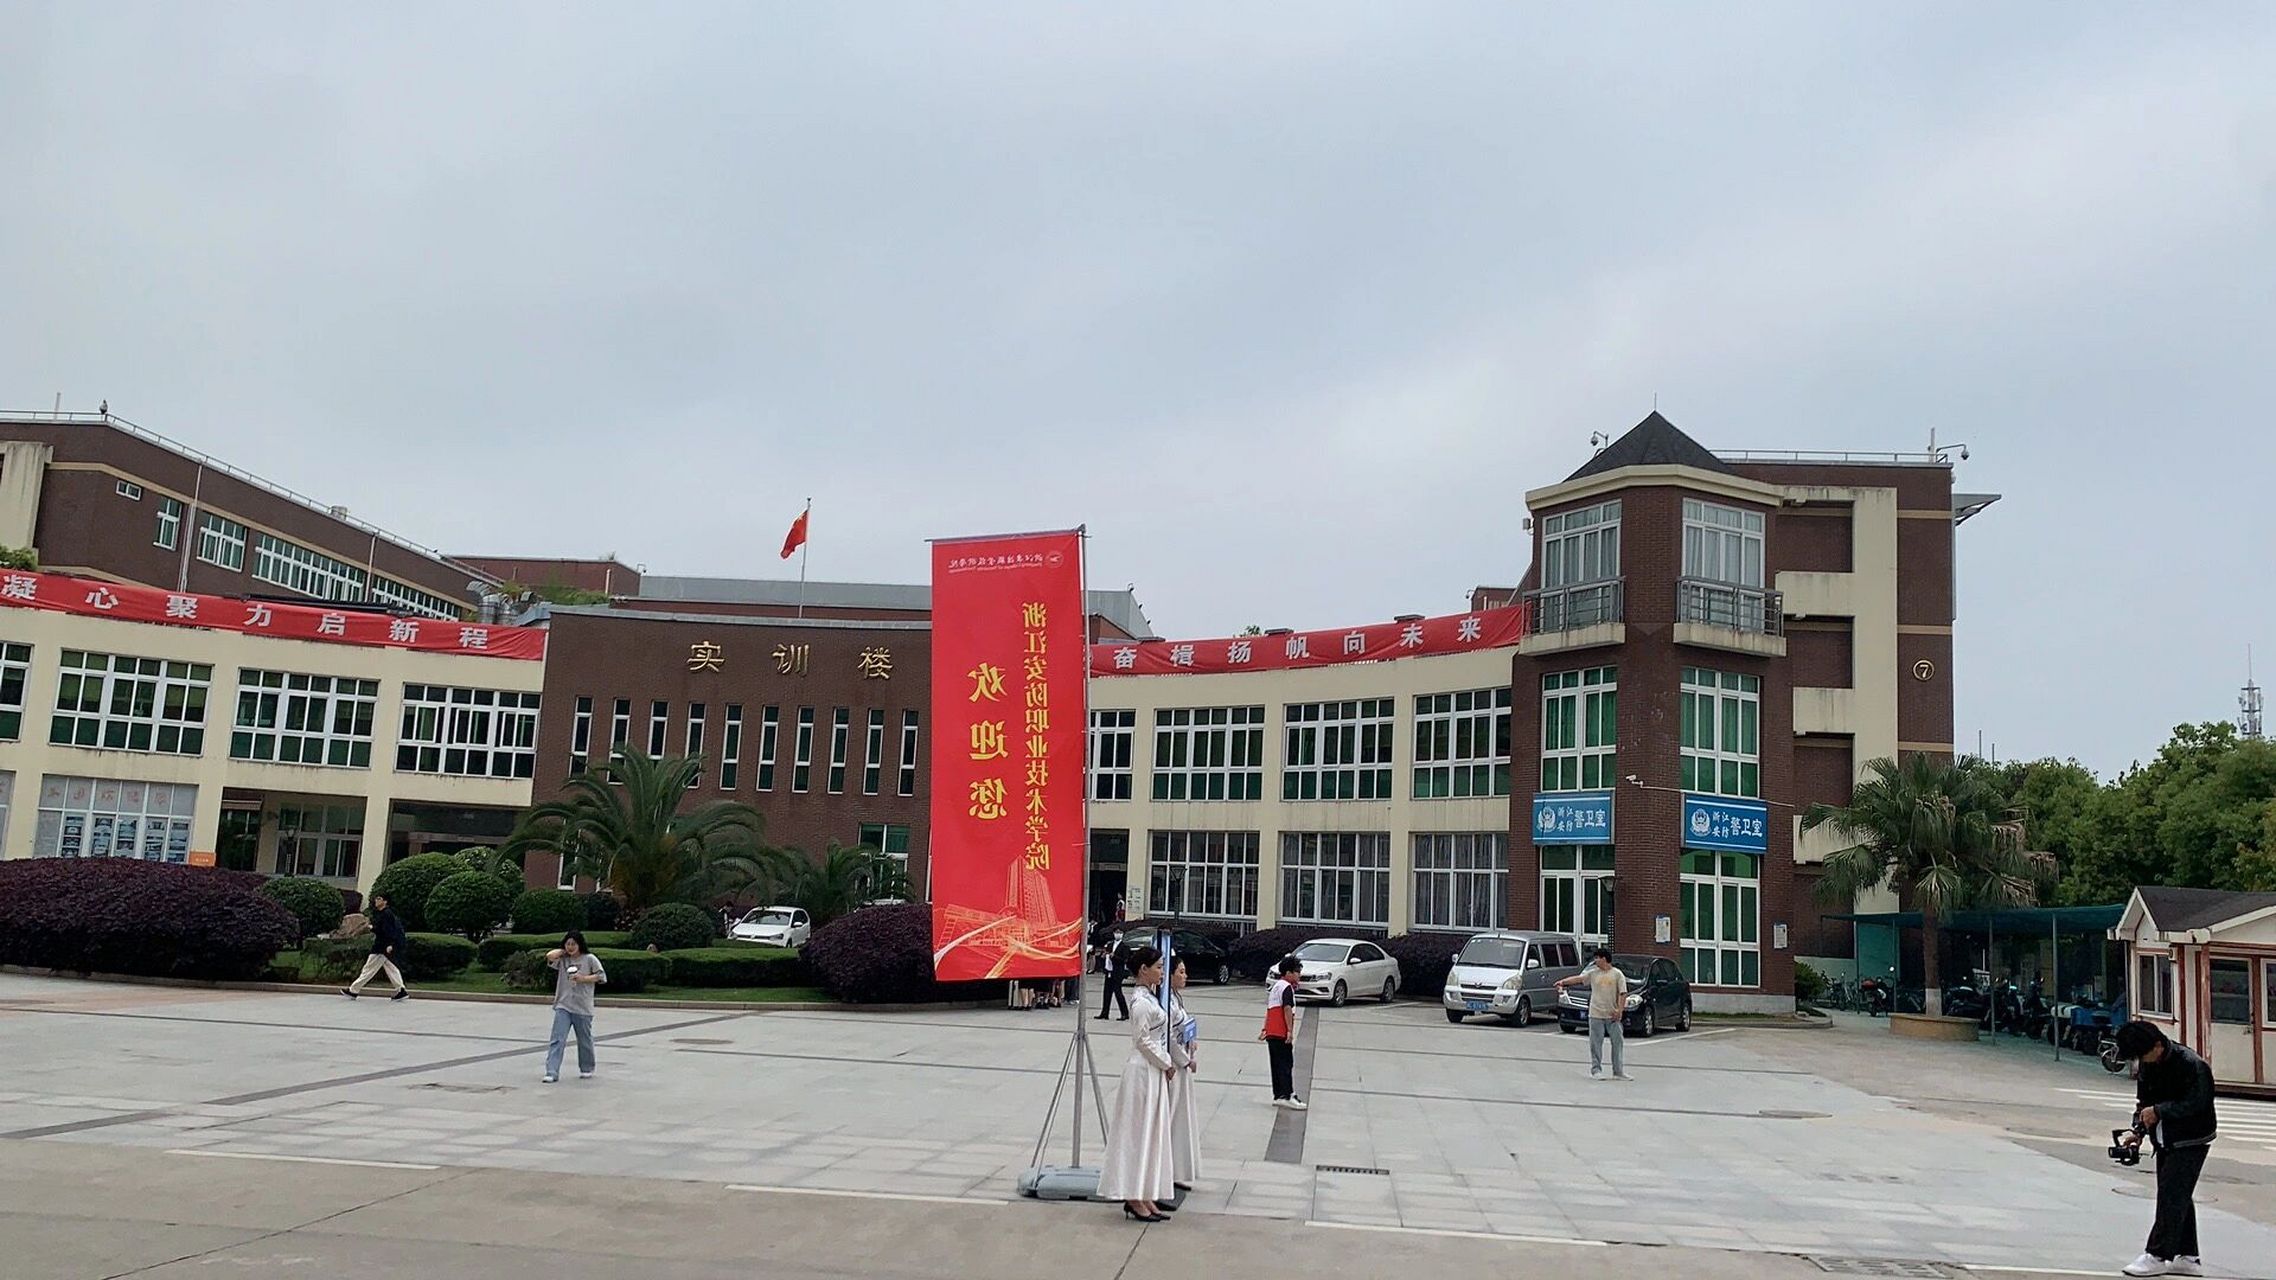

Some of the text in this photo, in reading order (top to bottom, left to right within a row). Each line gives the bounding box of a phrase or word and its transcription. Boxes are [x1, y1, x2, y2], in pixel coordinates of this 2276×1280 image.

[1, 573, 489, 650] 凝心聚力启新程
[687, 641, 894, 680] 实训楼
[1113, 616, 1482, 670] 奋楫扬帆向未来
[1574, 808, 1606, 829] 警卫室
[1730, 816, 1763, 838] 警卫室
